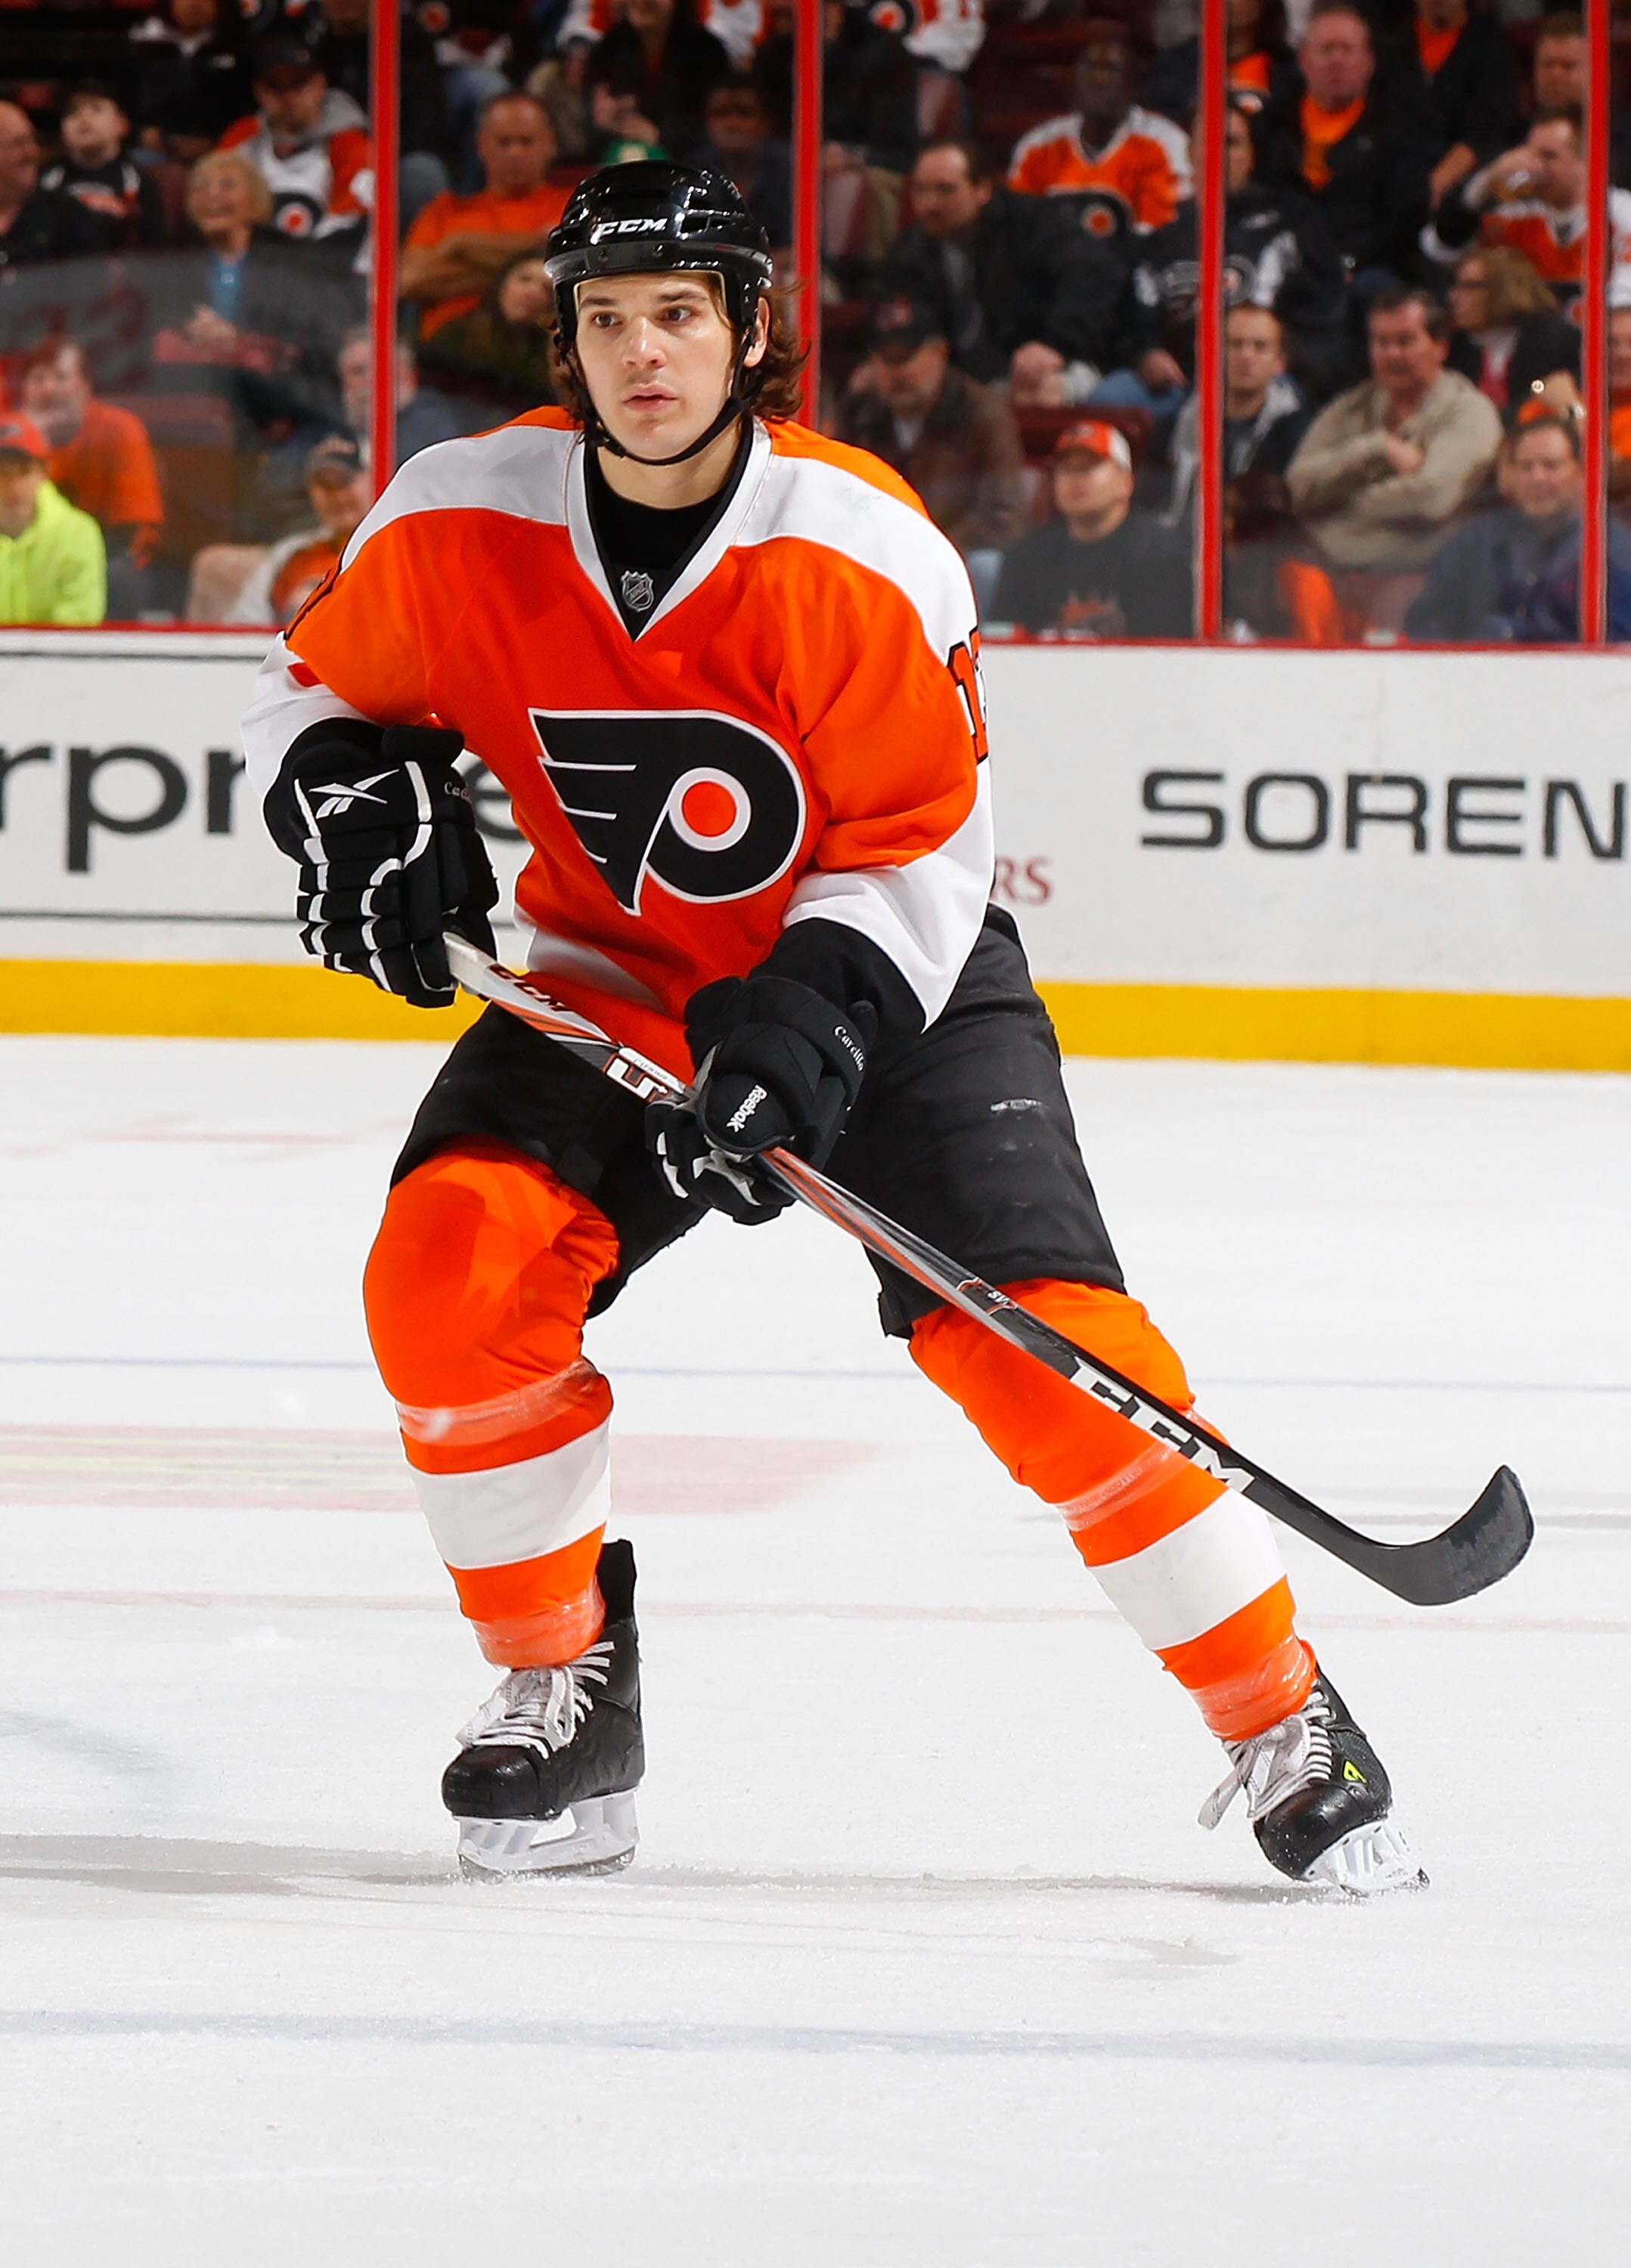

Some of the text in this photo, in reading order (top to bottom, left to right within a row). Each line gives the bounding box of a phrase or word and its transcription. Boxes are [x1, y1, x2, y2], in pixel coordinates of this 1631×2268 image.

[593, 218, 668, 240] CCM
[1142, 770, 1626, 859] SOREN
[726, 1084, 767, 1132] Reebok
[1069, 1356, 1255, 1492] CCM
